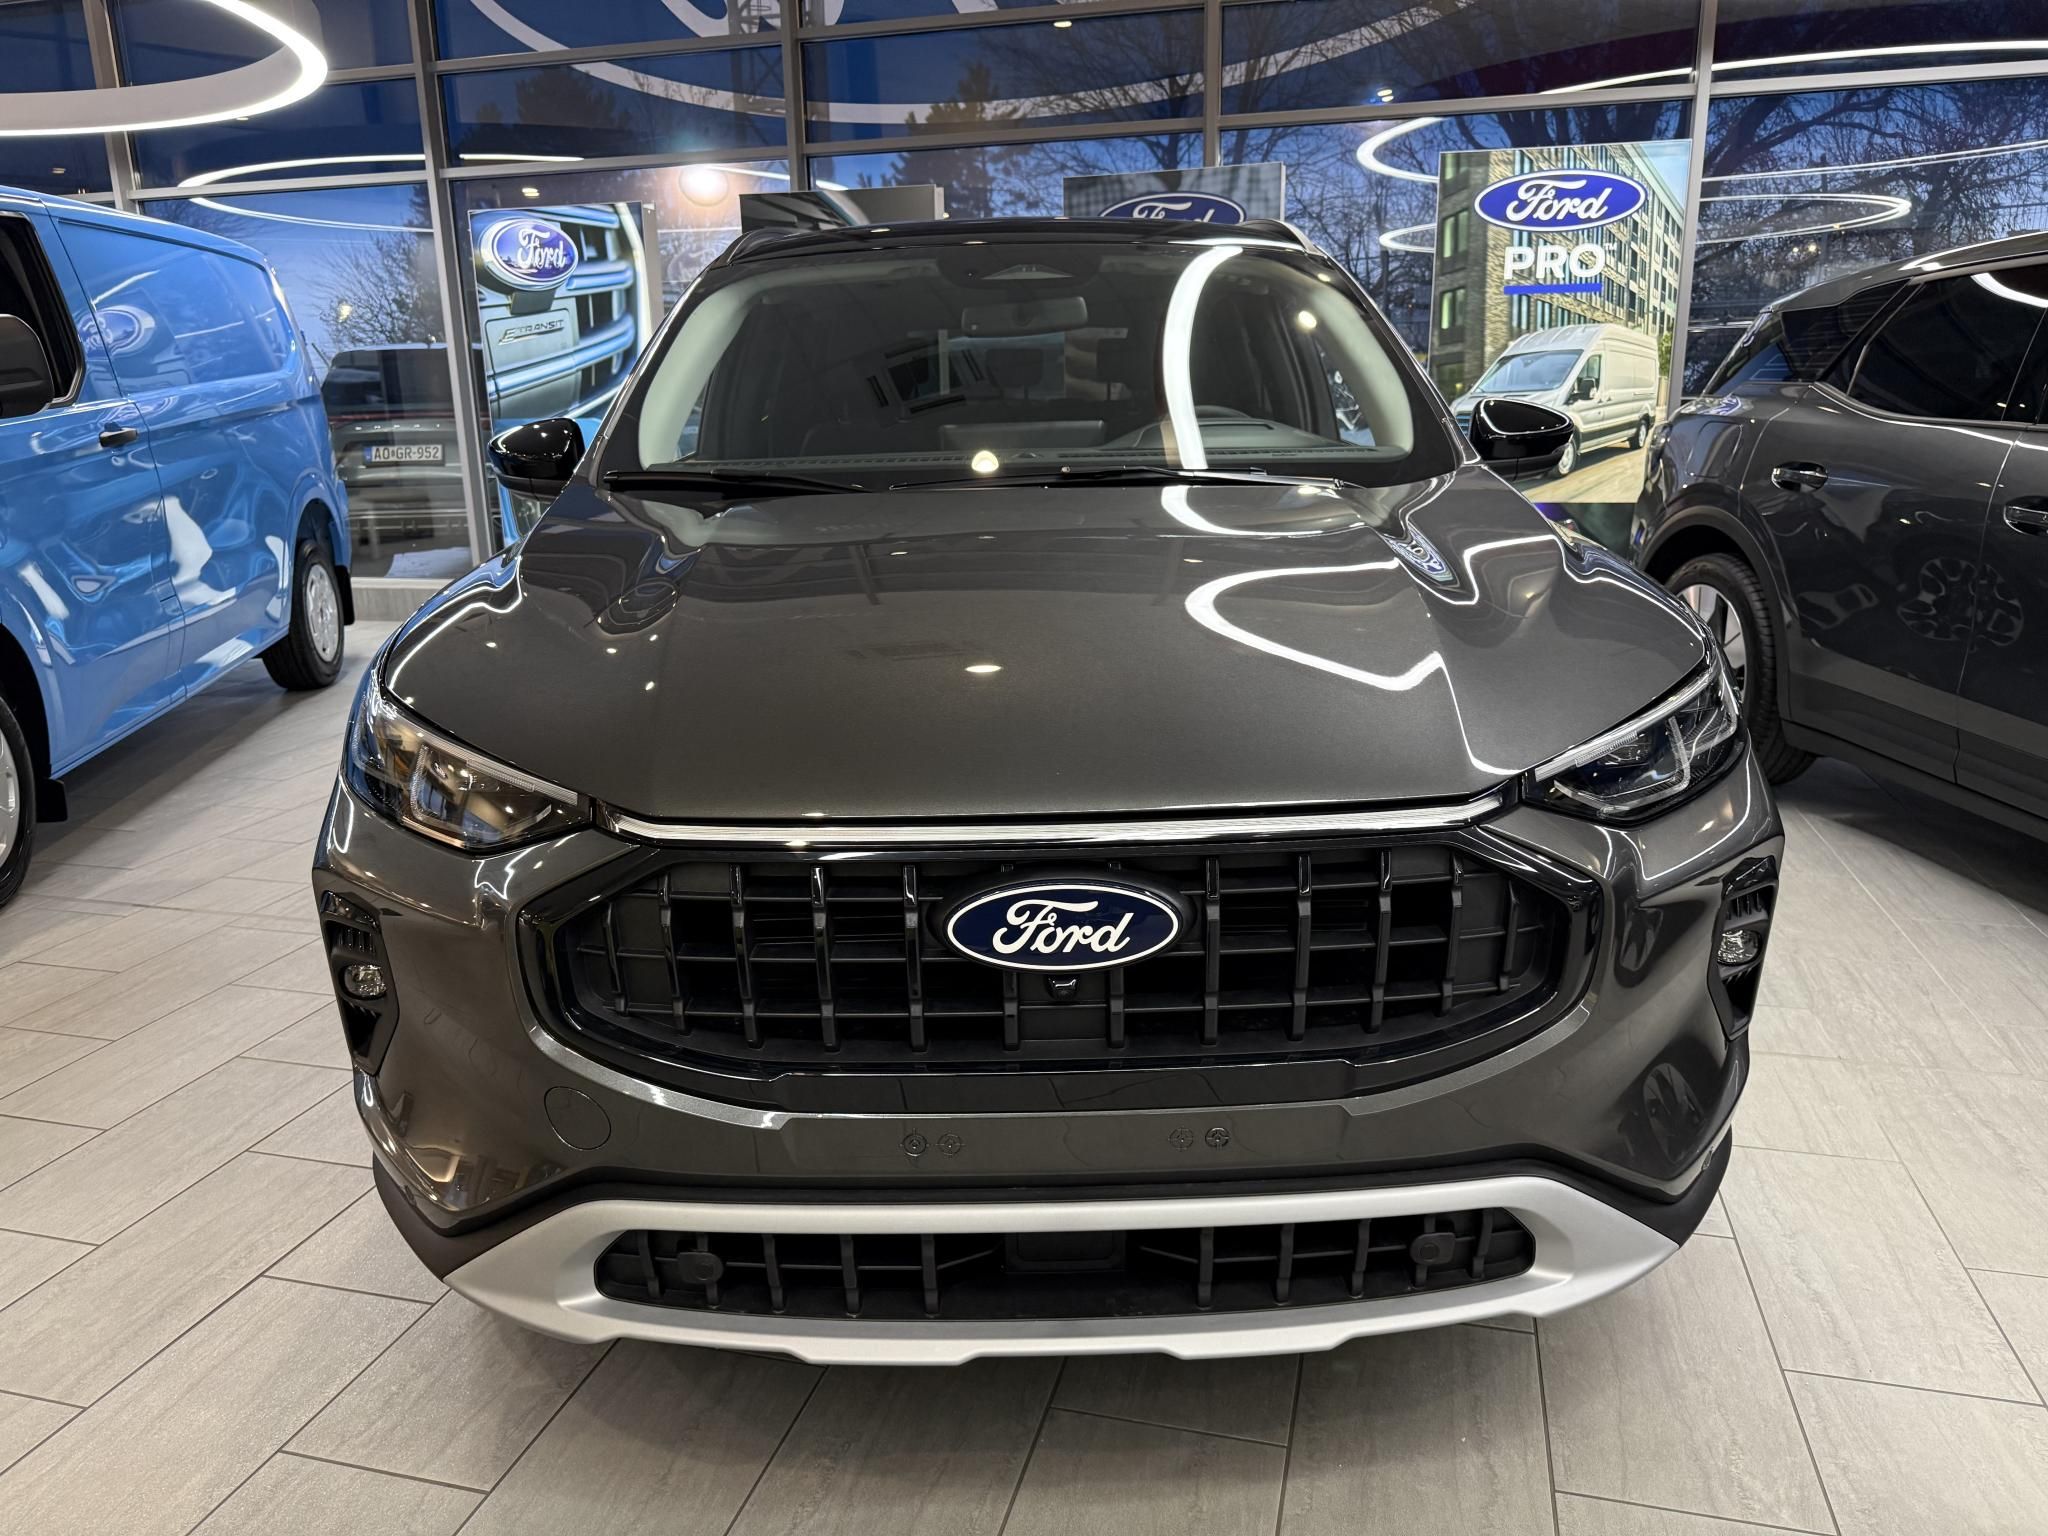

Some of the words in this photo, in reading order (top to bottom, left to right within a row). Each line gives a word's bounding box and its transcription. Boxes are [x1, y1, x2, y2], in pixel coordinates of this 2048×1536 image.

[1506, 179, 1612, 222] Ford
[517, 228, 567, 270] Ford
[1503, 243, 1606, 280] PRO
[992, 899, 1135, 954] Ford
